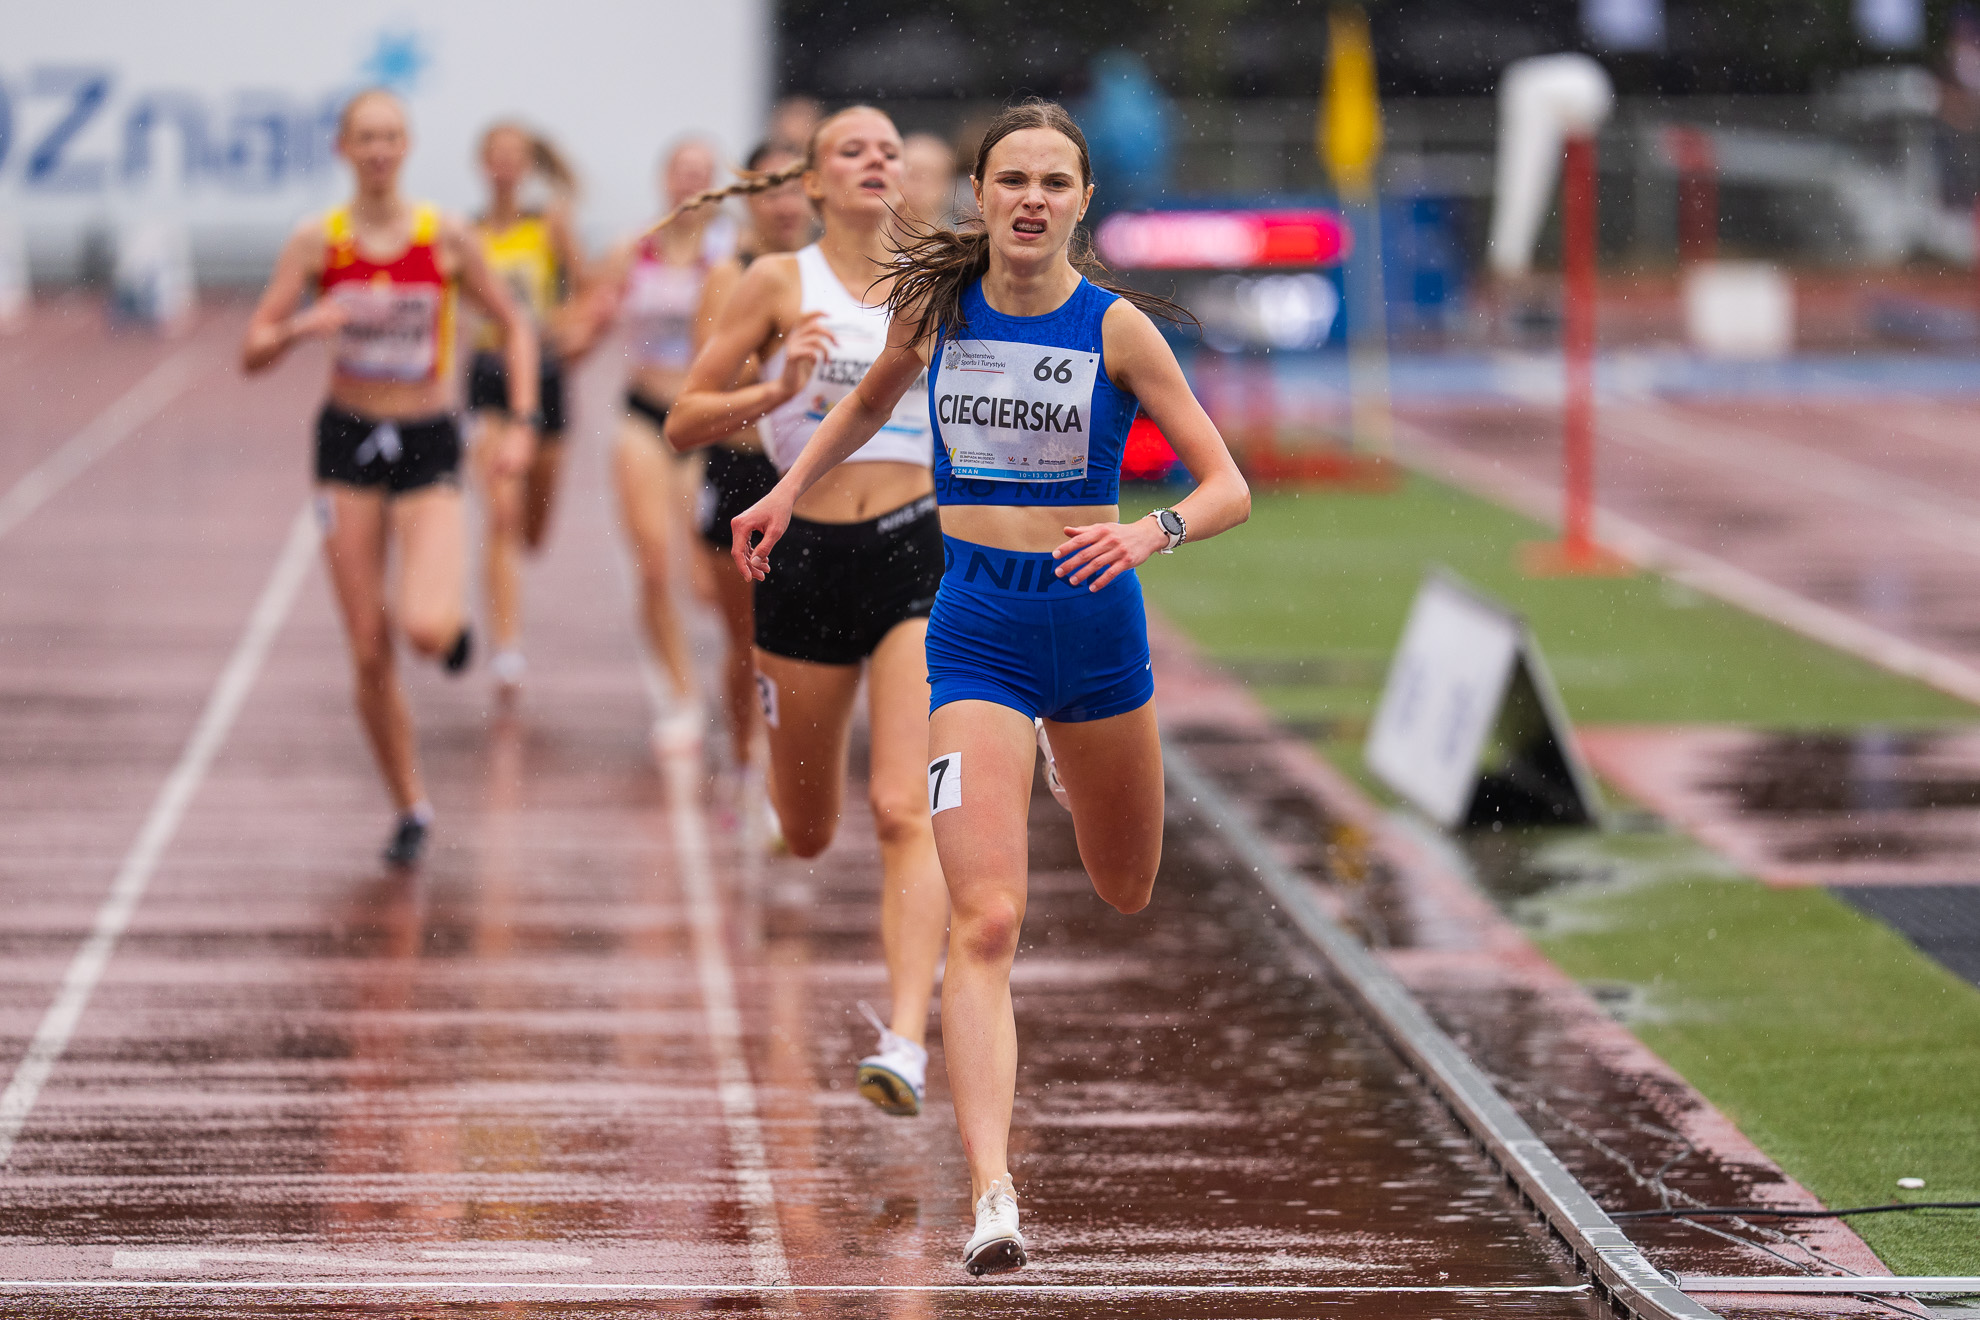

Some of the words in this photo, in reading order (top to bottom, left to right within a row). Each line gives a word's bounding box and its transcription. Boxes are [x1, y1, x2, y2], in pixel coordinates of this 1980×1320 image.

[981, 360, 1006, 368] Turystyki
[1033, 356, 1073, 384] 66
[938, 394, 1083, 433] CIECIERSKA
[935, 476, 996, 498] PRO
[1015, 478, 1103, 498] NIKE
[963, 550, 1100, 593] NIK
[930, 758, 950, 811] 7
